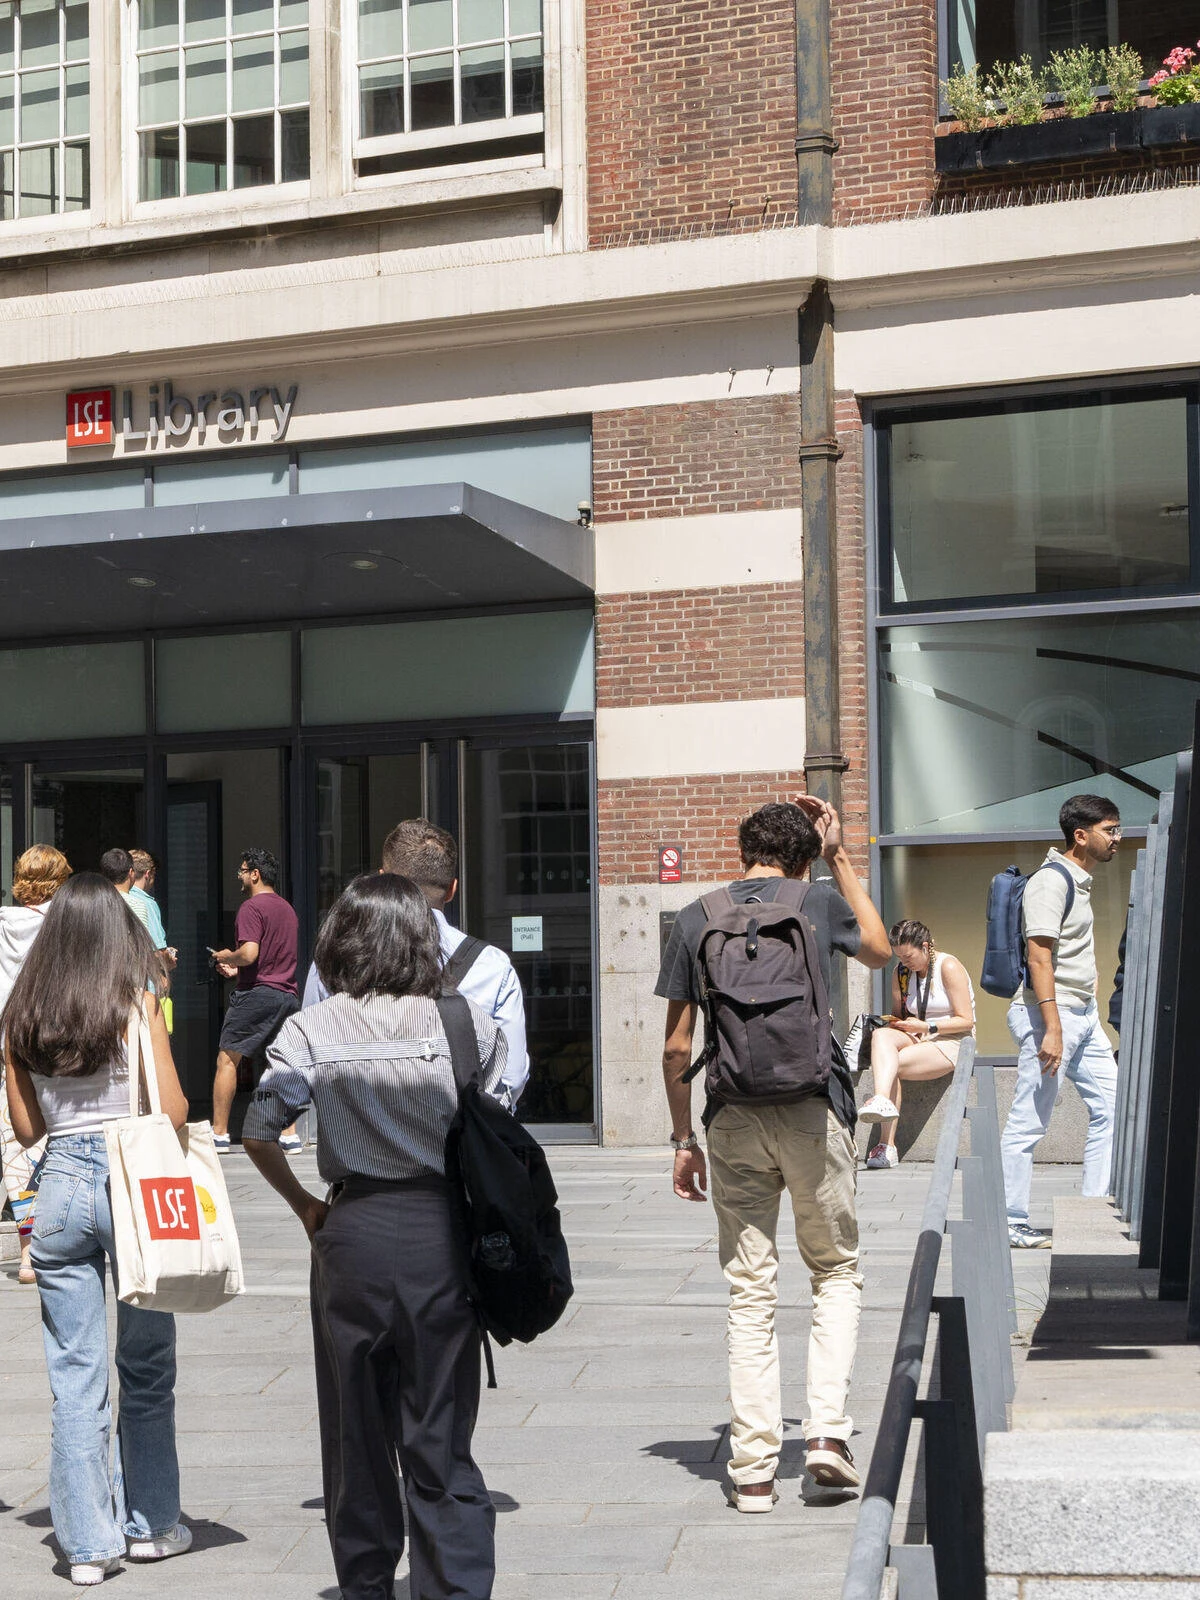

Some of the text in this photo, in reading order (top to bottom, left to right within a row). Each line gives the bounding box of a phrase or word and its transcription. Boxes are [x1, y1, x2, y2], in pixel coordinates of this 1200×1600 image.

[74, 382, 298, 442] LSE Library
[151, 1188, 190, 1229] LSE
